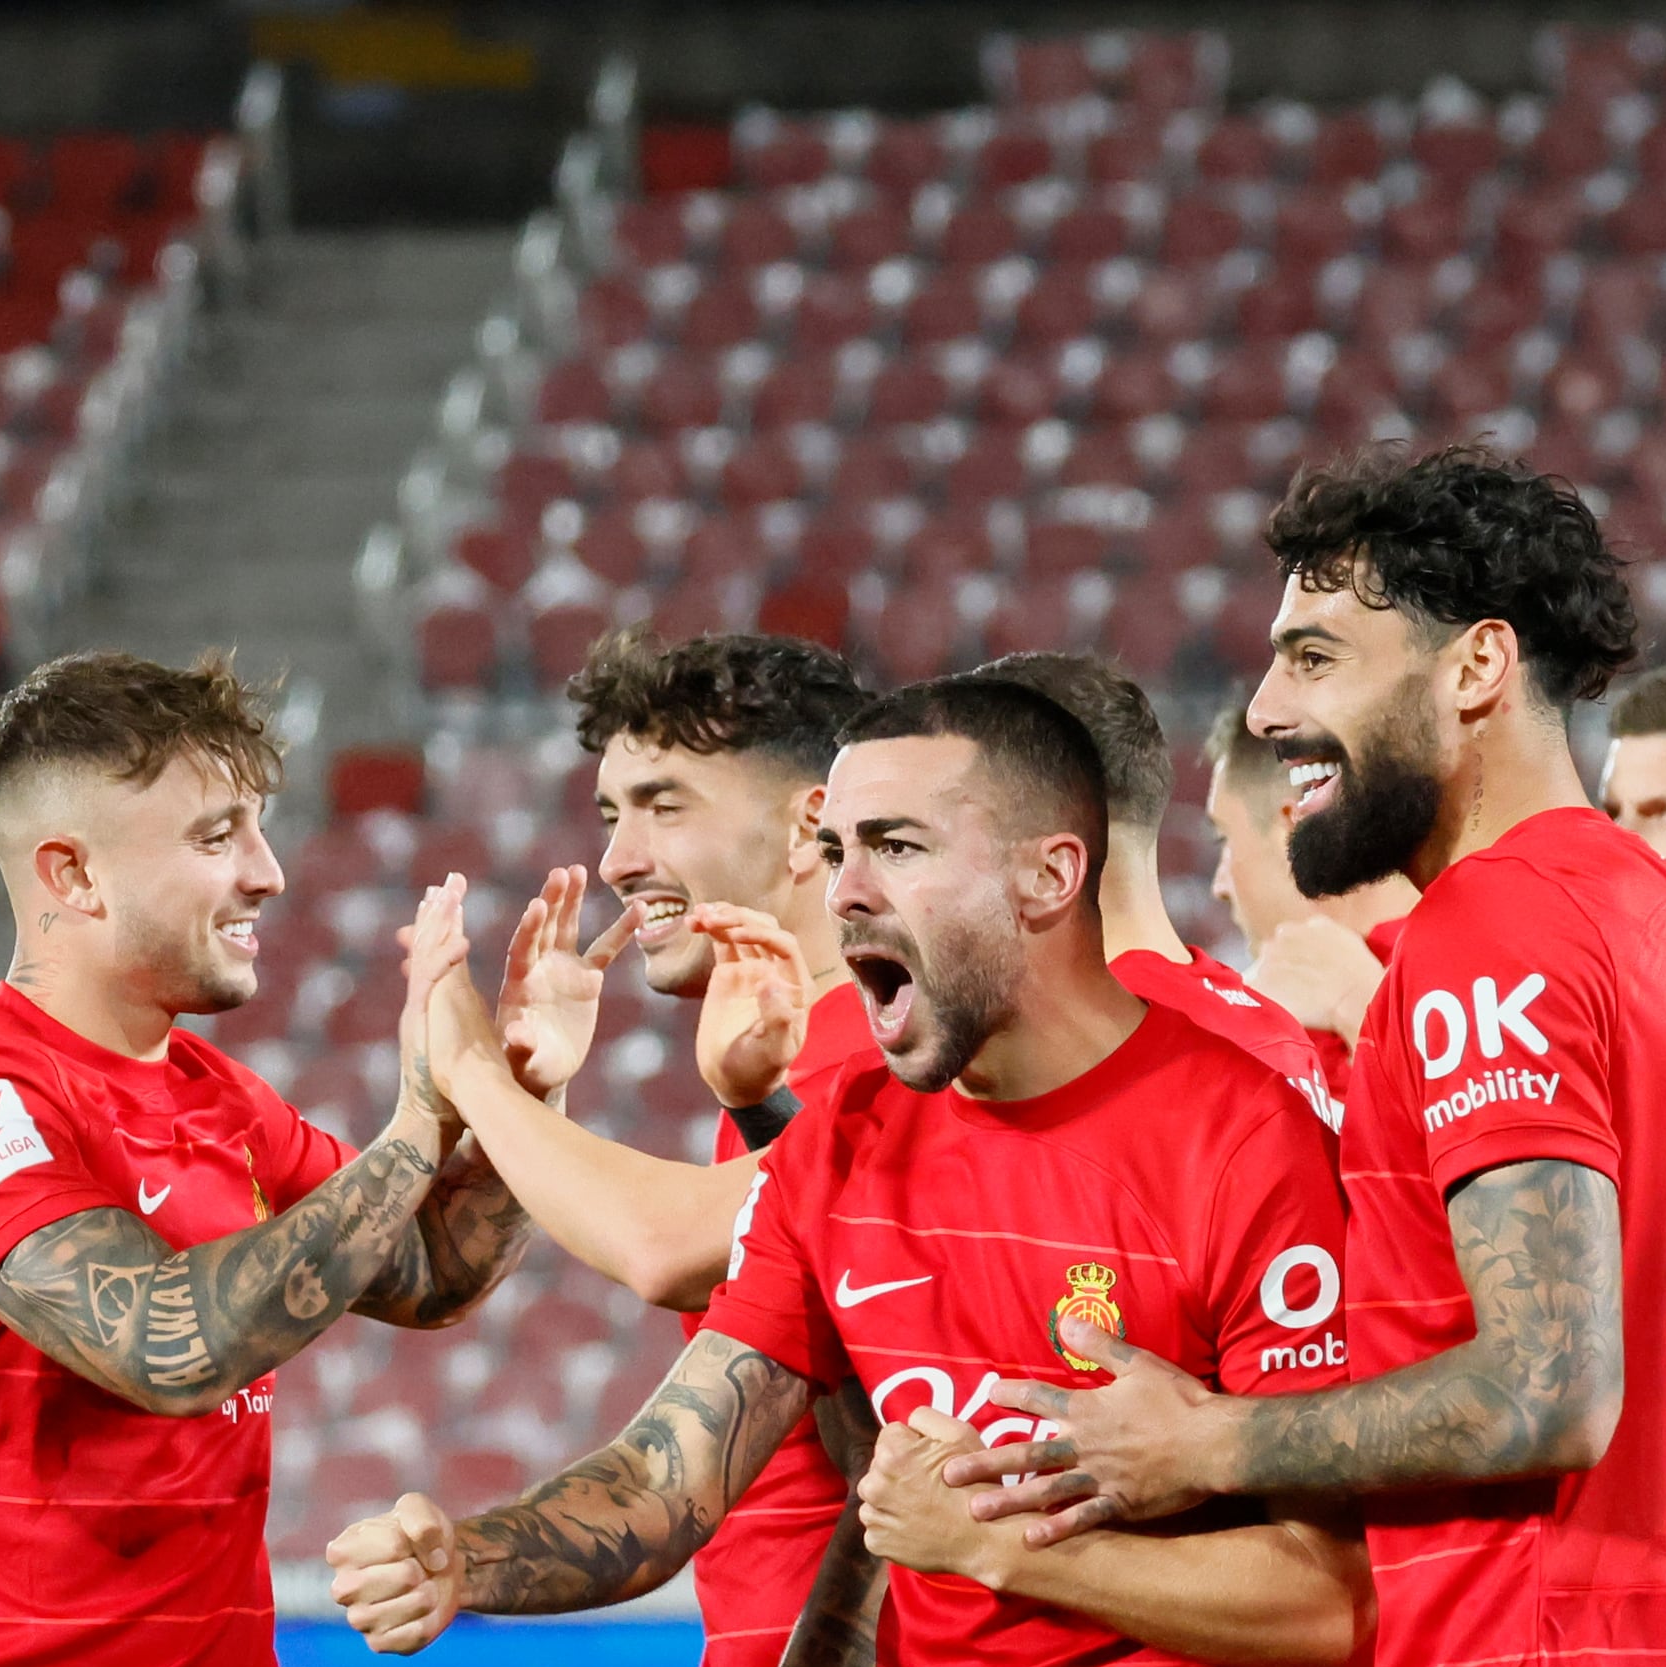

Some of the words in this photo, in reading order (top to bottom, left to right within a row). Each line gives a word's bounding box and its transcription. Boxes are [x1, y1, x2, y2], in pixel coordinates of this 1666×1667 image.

[1412, 972, 1550, 1079] OK
[1423, 1066, 1561, 1133] mobility
[145, 1251, 218, 1387] ALWAYS
[1260, 1244, 1341, 1329] O
[1260, 1332, 1349, 1373] mob
